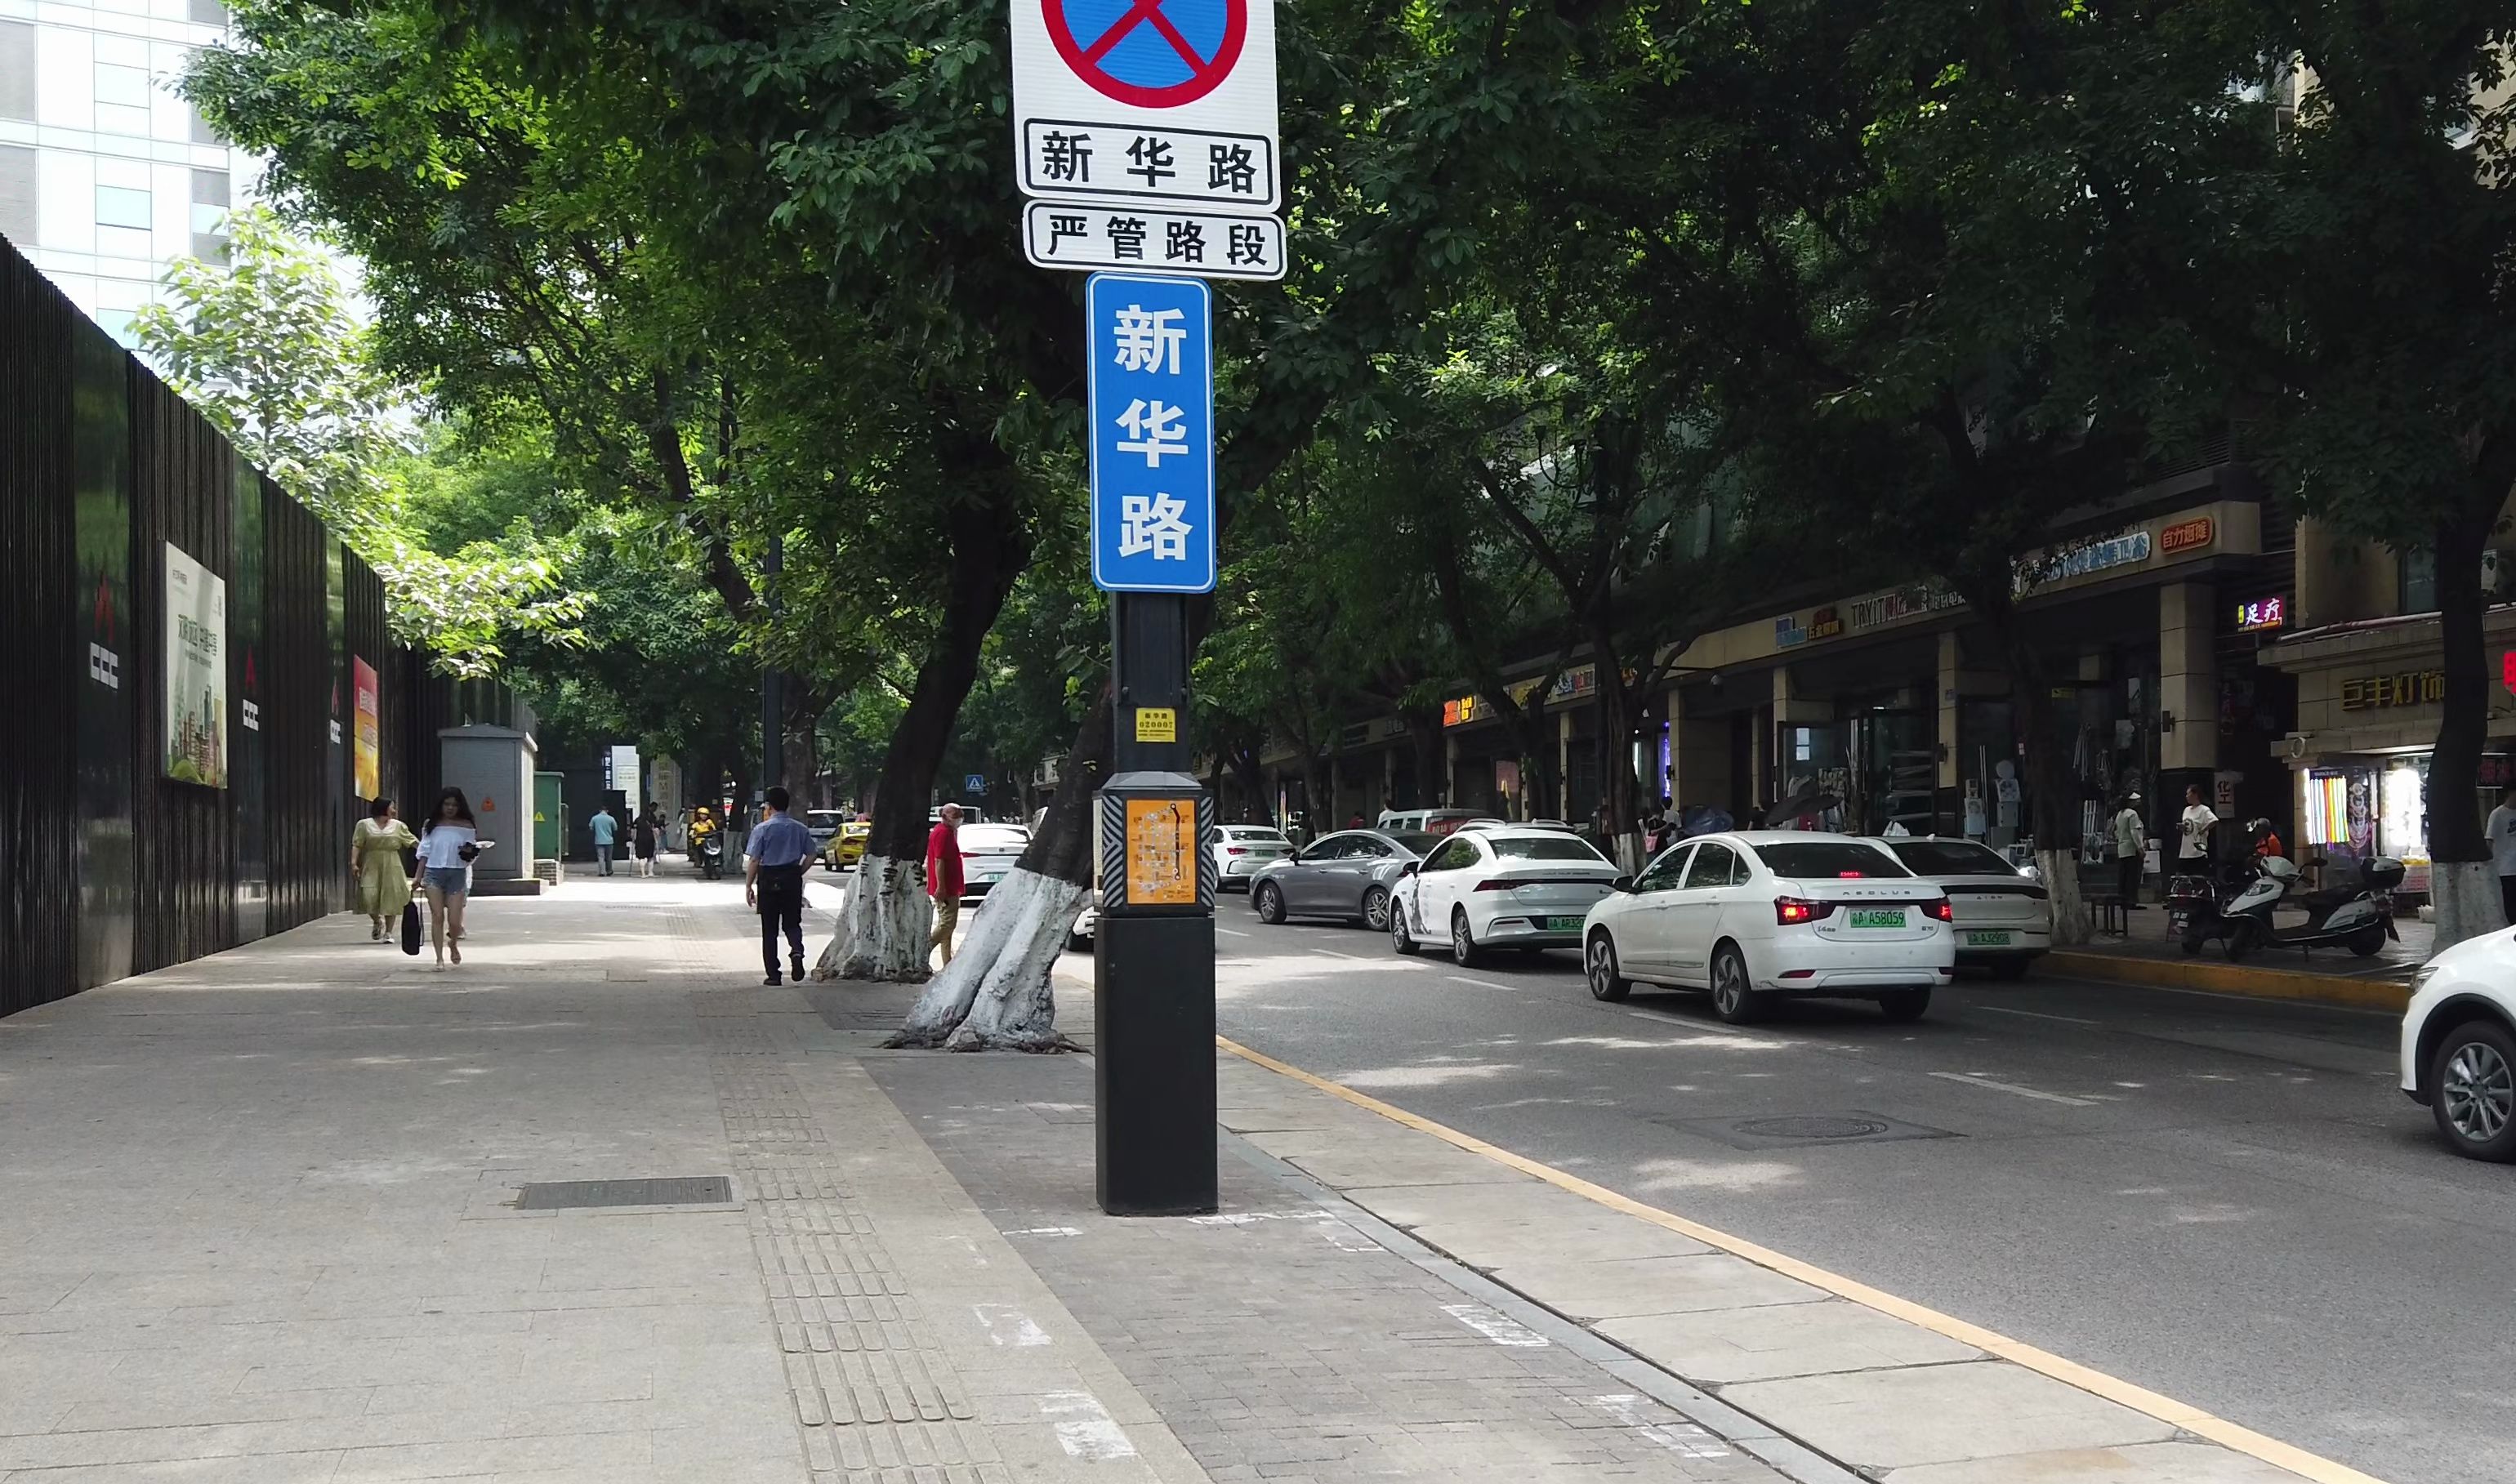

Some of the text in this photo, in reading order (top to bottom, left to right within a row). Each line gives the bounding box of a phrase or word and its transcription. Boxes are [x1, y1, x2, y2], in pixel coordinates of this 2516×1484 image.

[1041, 131, 1257, 194] 新华路
[1046, 213, 1269, 267] 严管路段
[1113, 303, 1193, 561] 新华路
[2245, 597, 2281, 626] 足疗
[2217, 780, 2232, 804] 化工
